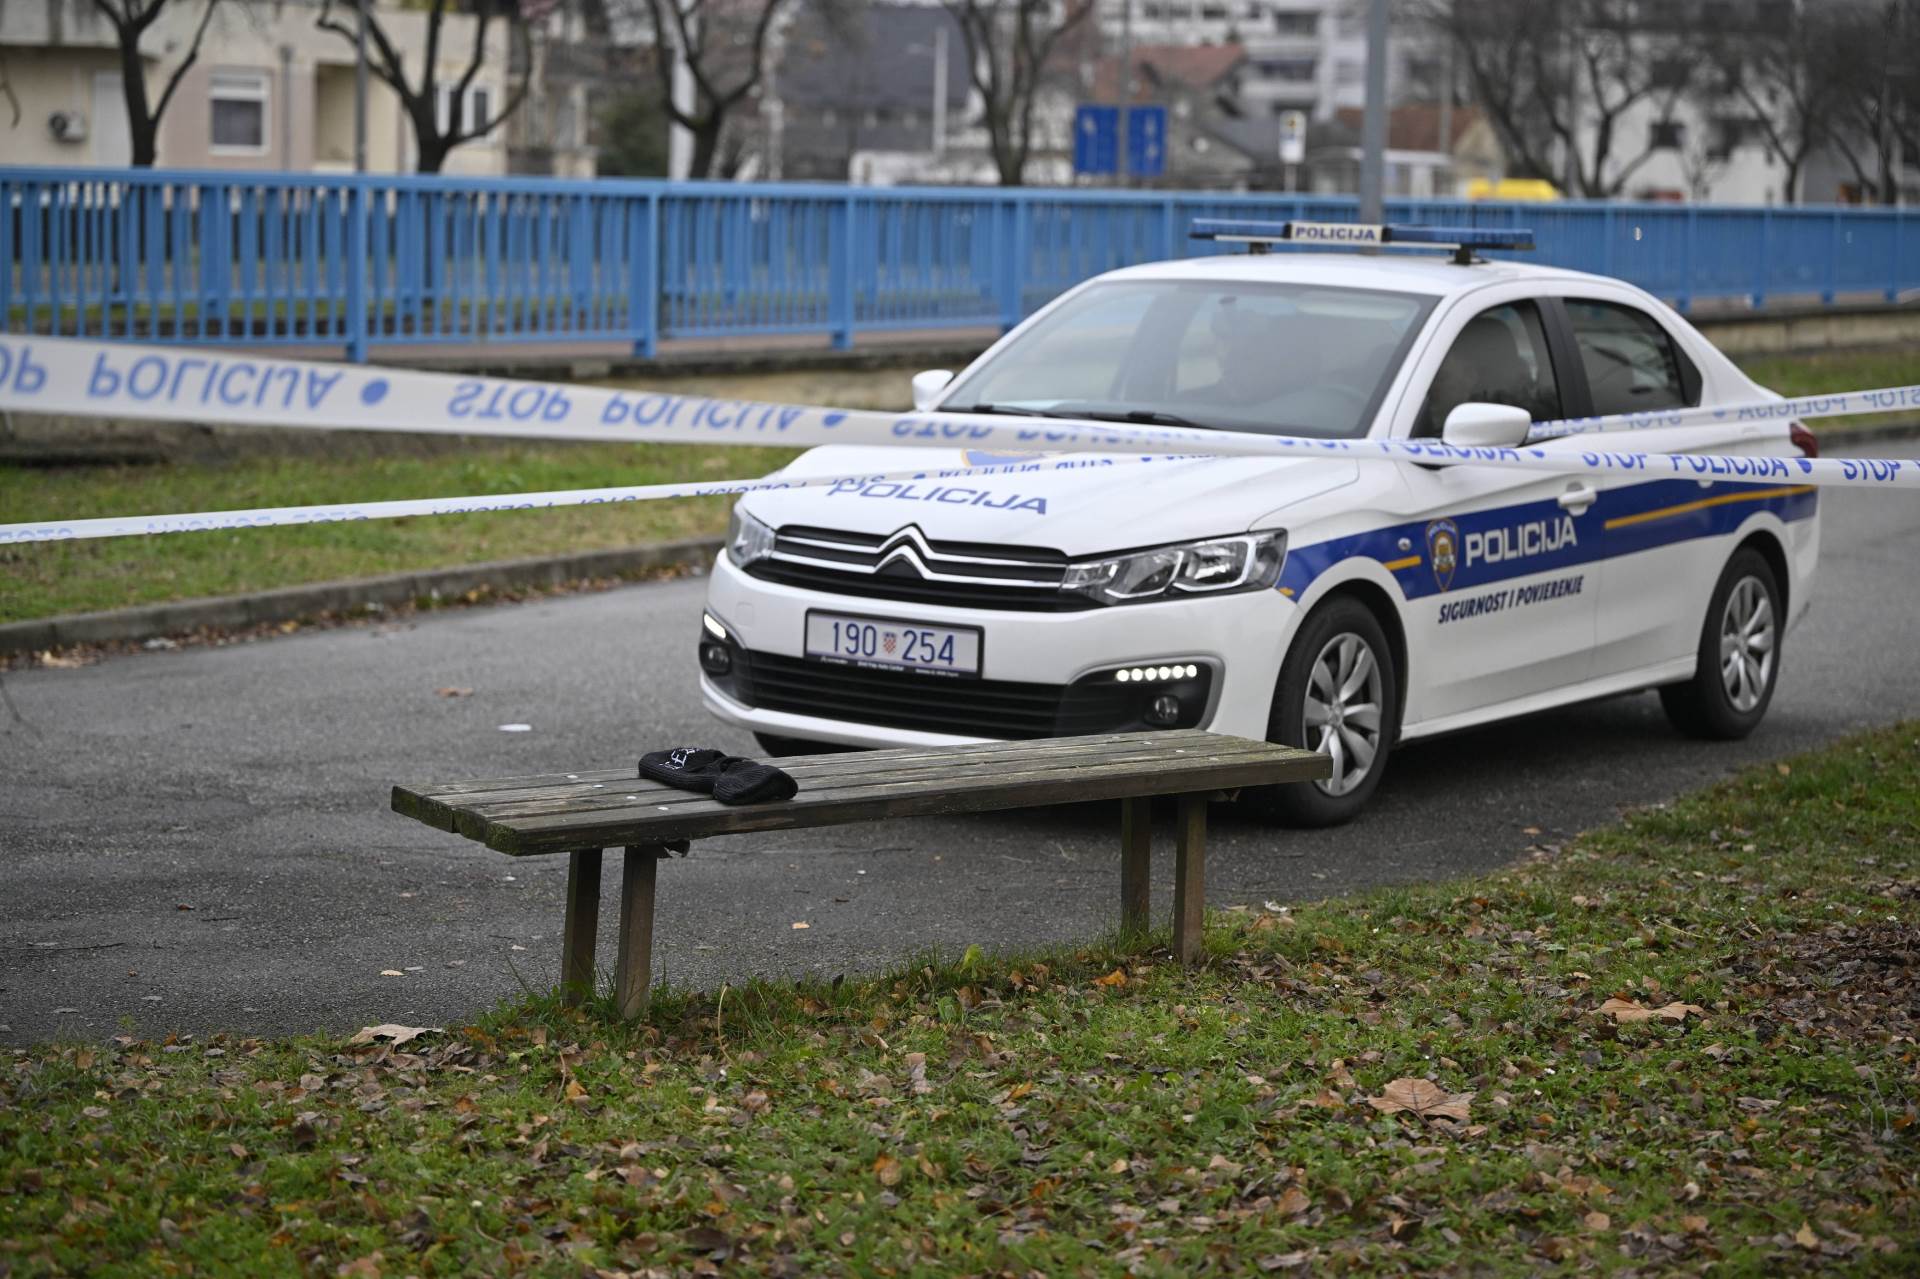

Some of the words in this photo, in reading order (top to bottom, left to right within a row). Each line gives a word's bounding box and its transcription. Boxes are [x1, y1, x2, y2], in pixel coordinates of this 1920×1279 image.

[1295, 226, 1376, 241] POLICIJA
[826, 477, 1048, 516] POLICIJA
[1465, 516, 1577, 567] POLICIJA
[1438, 591, 1507, 623] SIGURNOST
[1508, 590, 1515, 608] I
[1516, 575, 1584, 606] POVJERENJE
[834, 622, 877, 656] 190
[902, 630, 954, 665] 254
